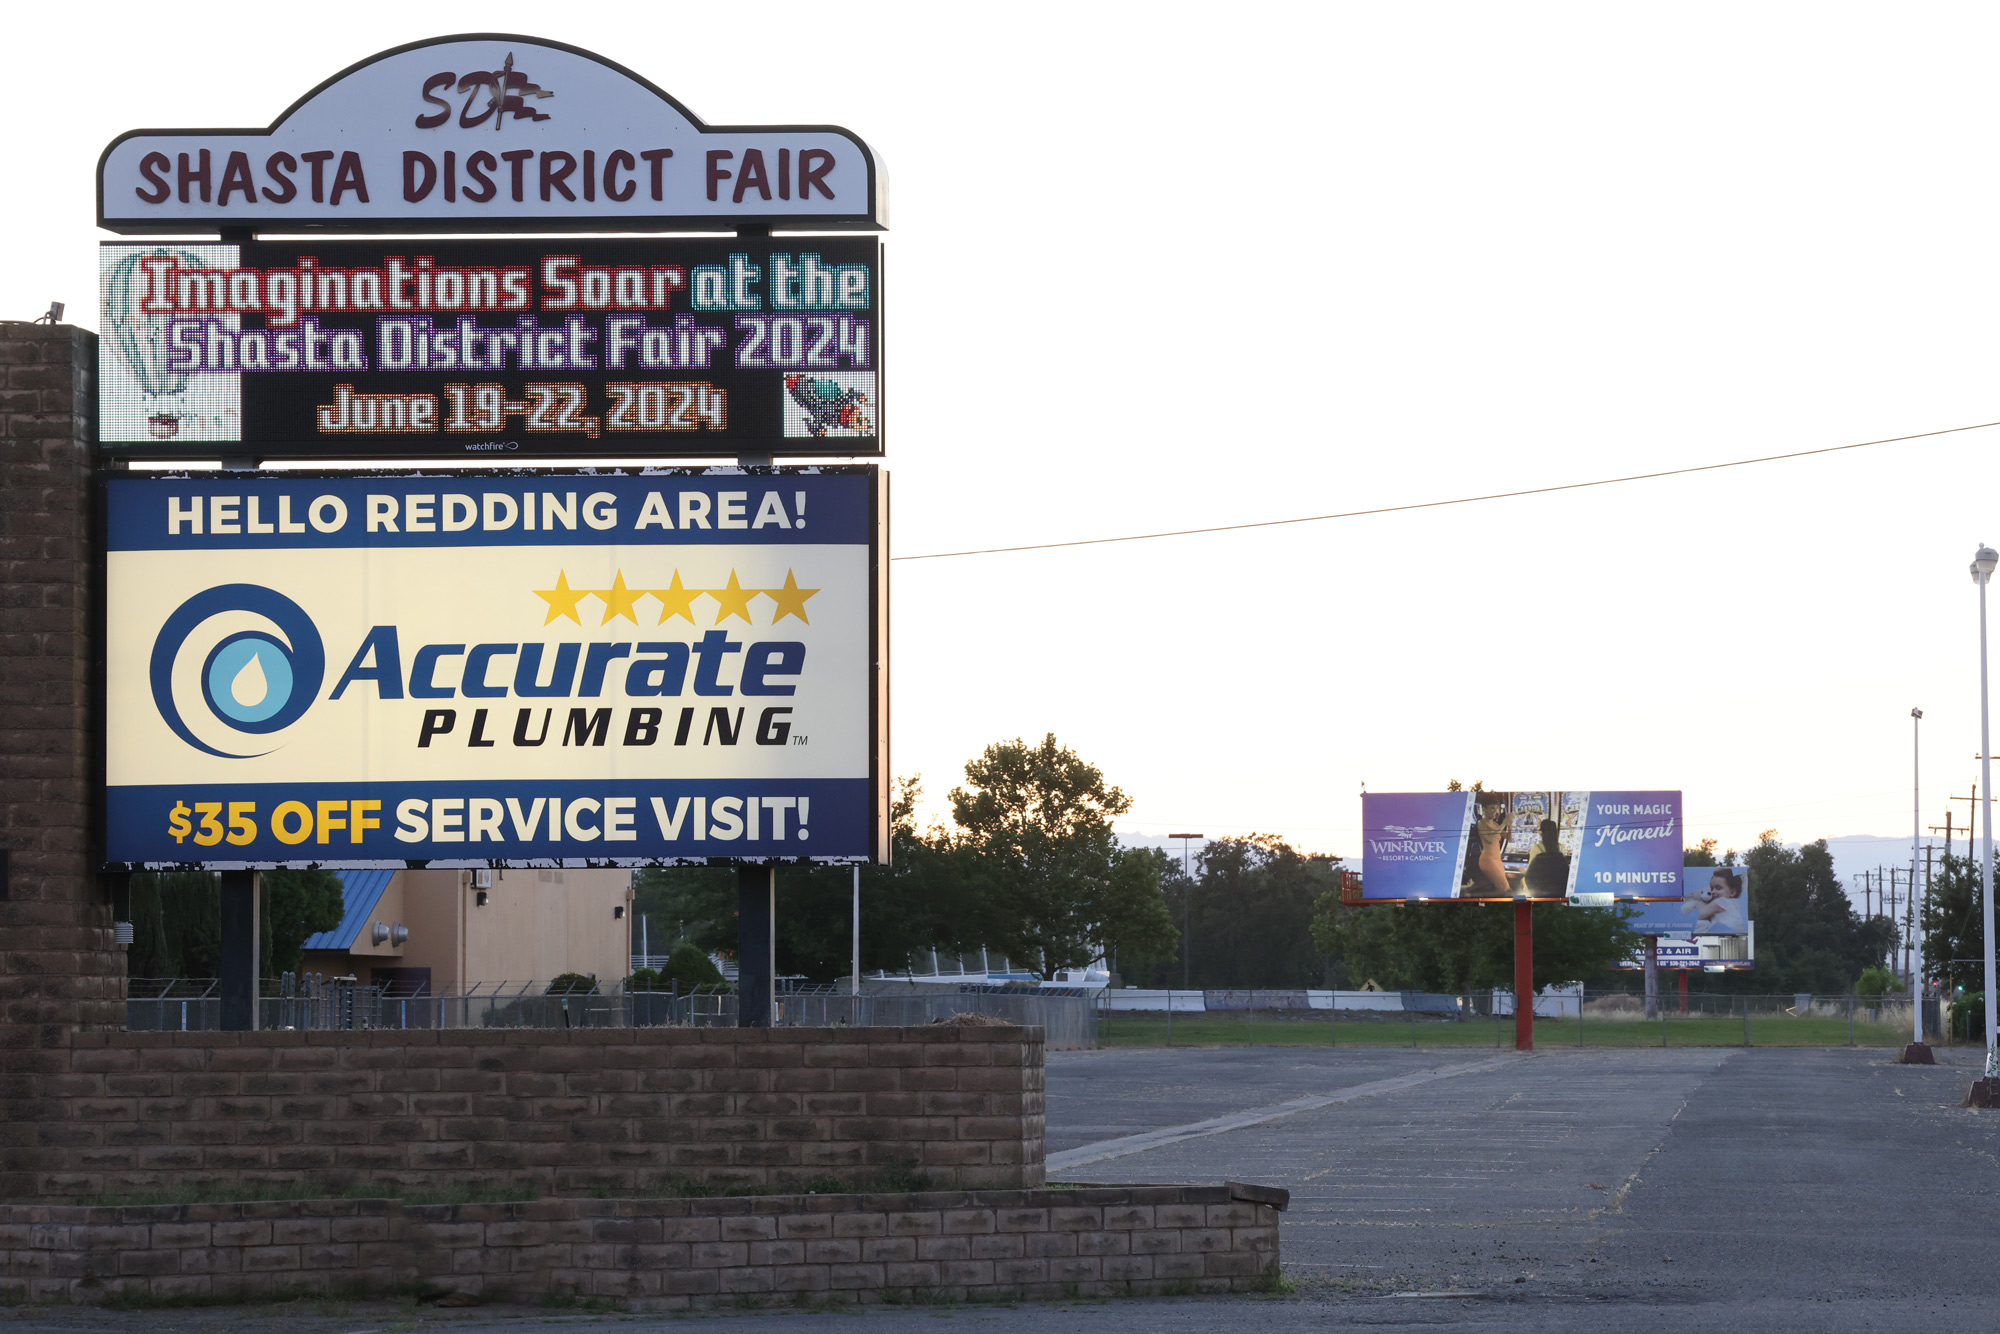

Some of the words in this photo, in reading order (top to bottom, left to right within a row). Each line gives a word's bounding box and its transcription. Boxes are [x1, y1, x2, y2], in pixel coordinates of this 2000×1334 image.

[135, 150, 370, 206] SHASTA
[403, 148, 673, 203] DISTRICT
[705, 147, 837, 202] FAIR
[141, 253, 531, 328] Imaginations
[541, 253, 684, 312] Soar
[691, 252, 760, 311] at
[769, 251, 869, 311] the
[167, 316, 368, 373] Shasta
[376, 315, 598, 372] District
[605, 313, 725, 371] Fair
[734, 313, 870, 370] 2024
[316, 383, 438, 434] June
[444, 381, 601, 439] 19-22,
[605, 380, 728, 432] 2024
[465, 441, 504, 451] watchfire
[167, 494, 349, 536] HELLO
[365, 492, 619, 533] REDDING
[634, 491, 809, 531] AREA!
[329, 625, 806, 701] Accurate
[417, 706, 792, 748] PLUMBING
[167, 800, 258, 847] $35
[271, 800, 382, 845] OFF
[394, 797, 637, 843] SERVICE
[650, 796, 811, 841] VISIT!
[1594, 817, 1675, 847] Moment
[1596, 804, 1630, 815] YOUR
[1633, 804, 1672, 815] MAGIC
[1594, 871, 1612, 884] 10
[1615, 871, 1676, 884] MINUTES
